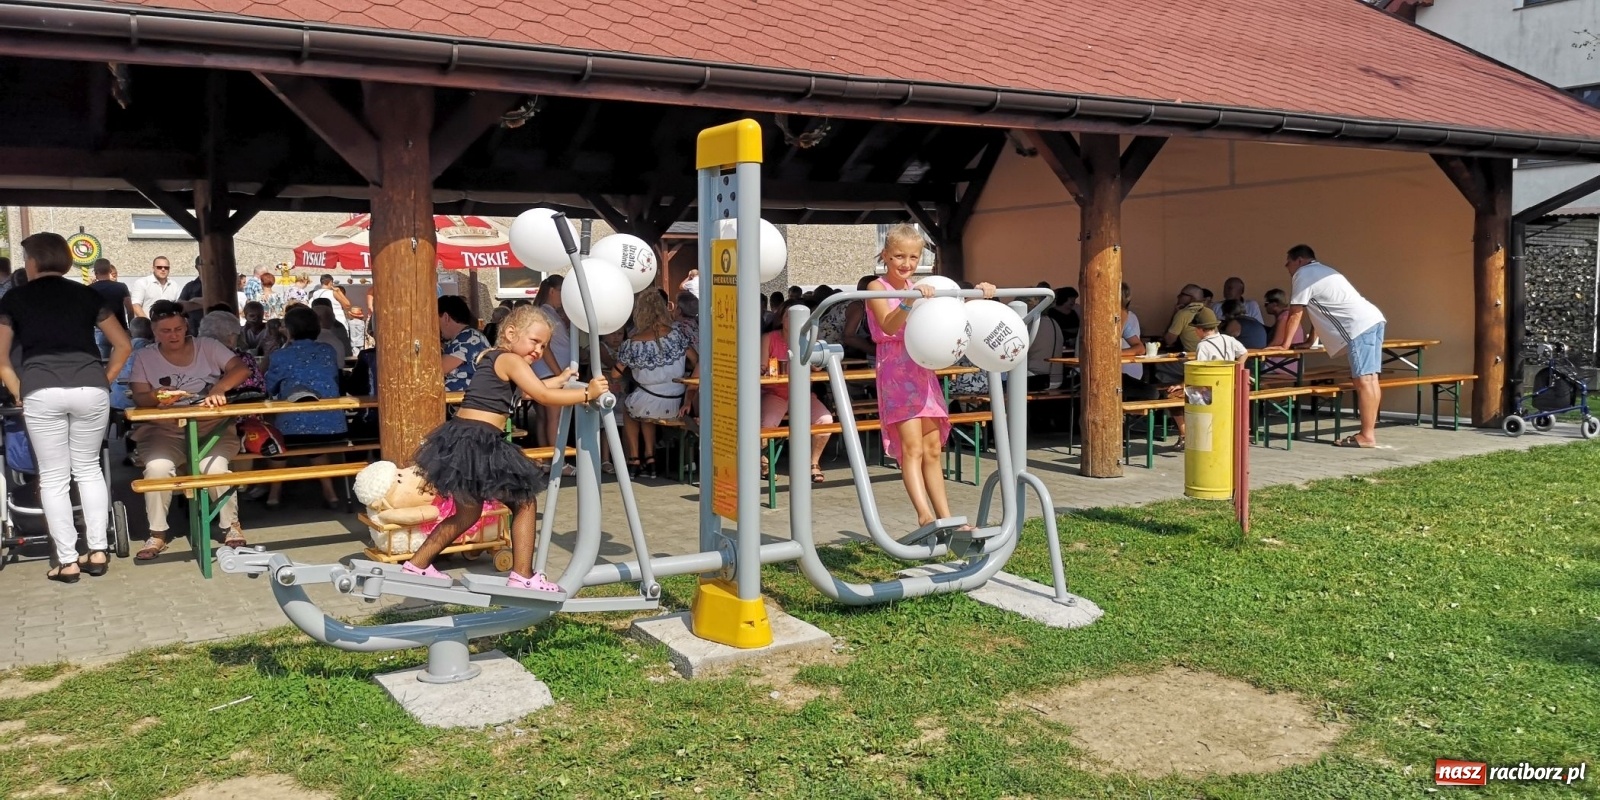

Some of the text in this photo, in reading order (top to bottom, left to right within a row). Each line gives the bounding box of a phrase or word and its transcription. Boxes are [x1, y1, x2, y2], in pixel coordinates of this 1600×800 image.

[302, 249, 327, 267] TYSKIE
[460, 250, 510, 267] TYSKIE
[713, 276, 738, 285] HERKULES
